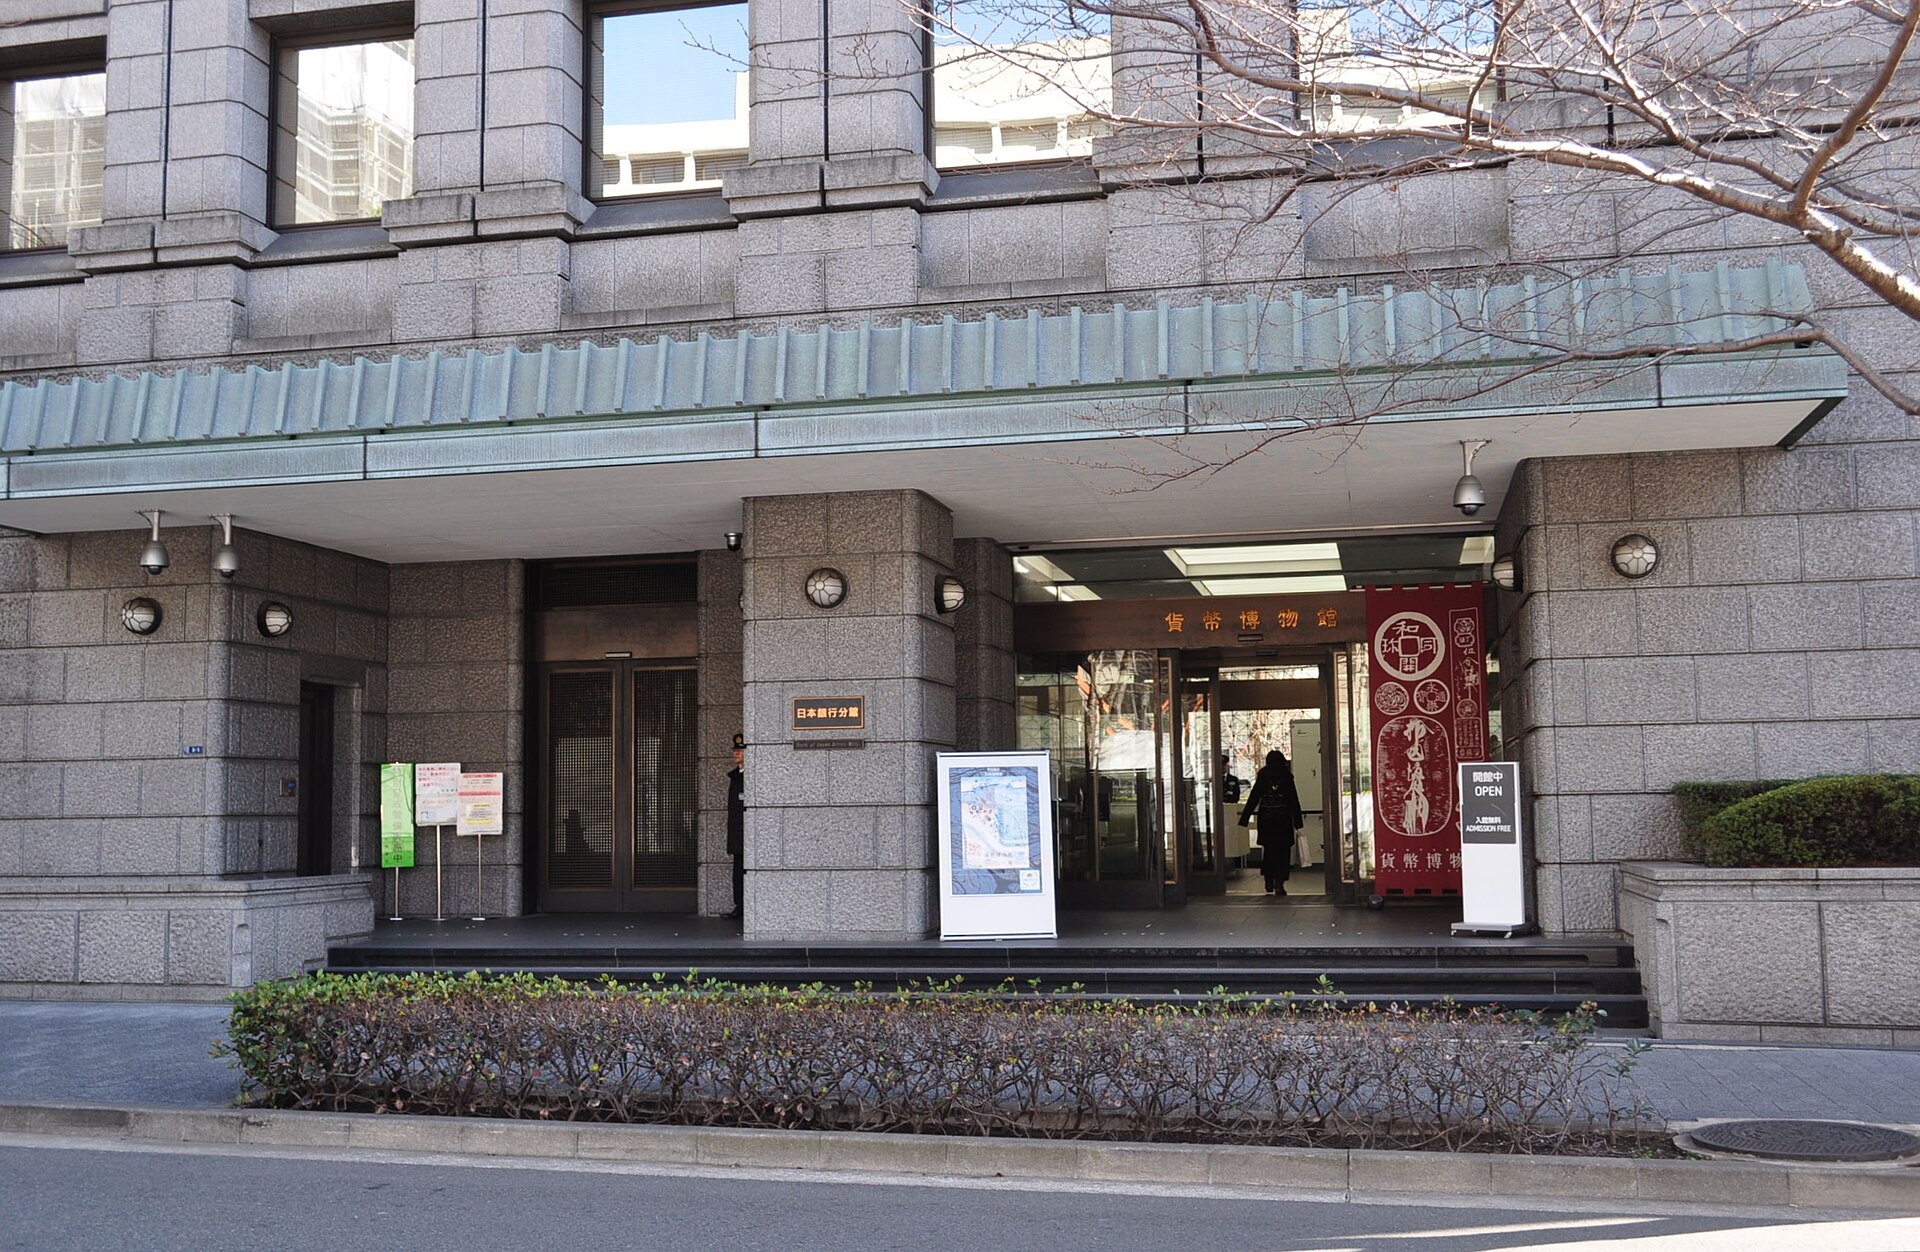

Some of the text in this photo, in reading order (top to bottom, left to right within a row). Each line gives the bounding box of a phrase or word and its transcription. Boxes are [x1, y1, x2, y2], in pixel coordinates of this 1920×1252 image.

[1164, 607, 1338, 633] 貨幣博物館
[797, 706, 859, 719] 日本銀行分館
[1472, 771, 1503, 783] 開館中
[1474, 785, 1503, 797] OPEN
[1465, 824, 1512, 833] ADMISSION FREE
